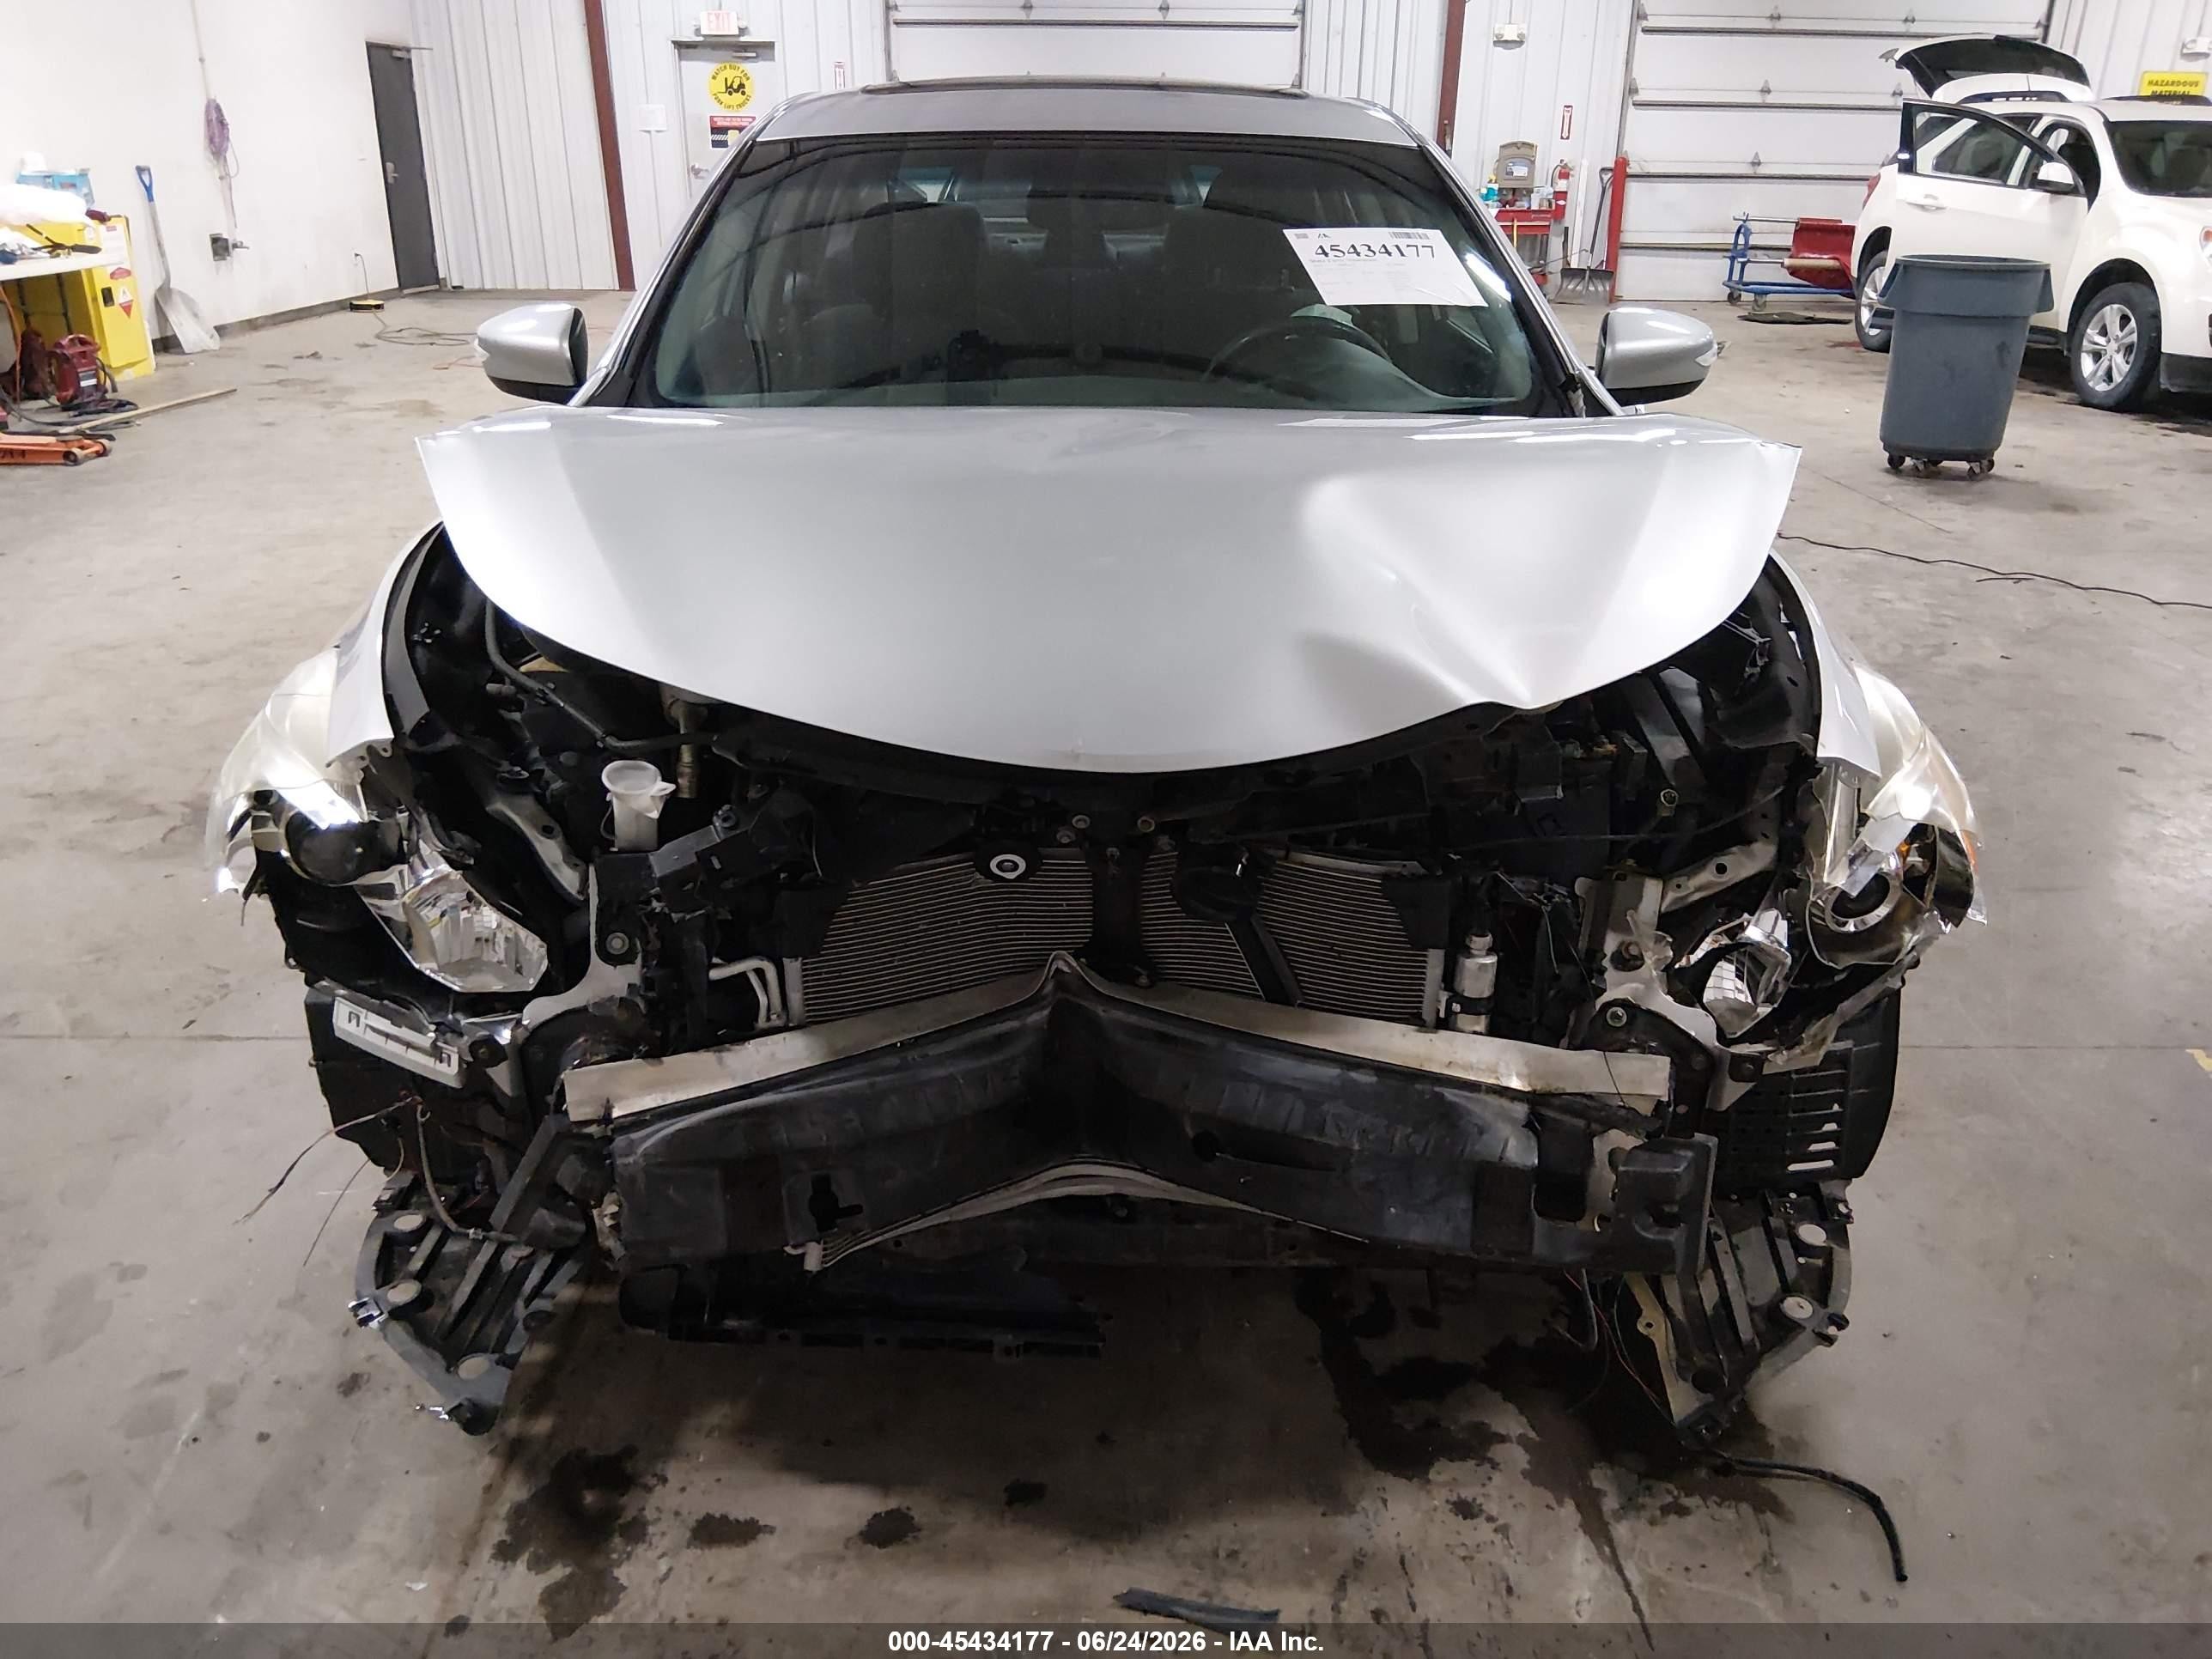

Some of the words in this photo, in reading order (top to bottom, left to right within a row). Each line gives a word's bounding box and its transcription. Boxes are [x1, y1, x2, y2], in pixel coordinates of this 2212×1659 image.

[707, 12, 731, 32] EXIT
[711, 64, 727, 81] WATCH
[740, 69, 750, 81] FOR
[1315, 243, 1435, 258] 45434177
